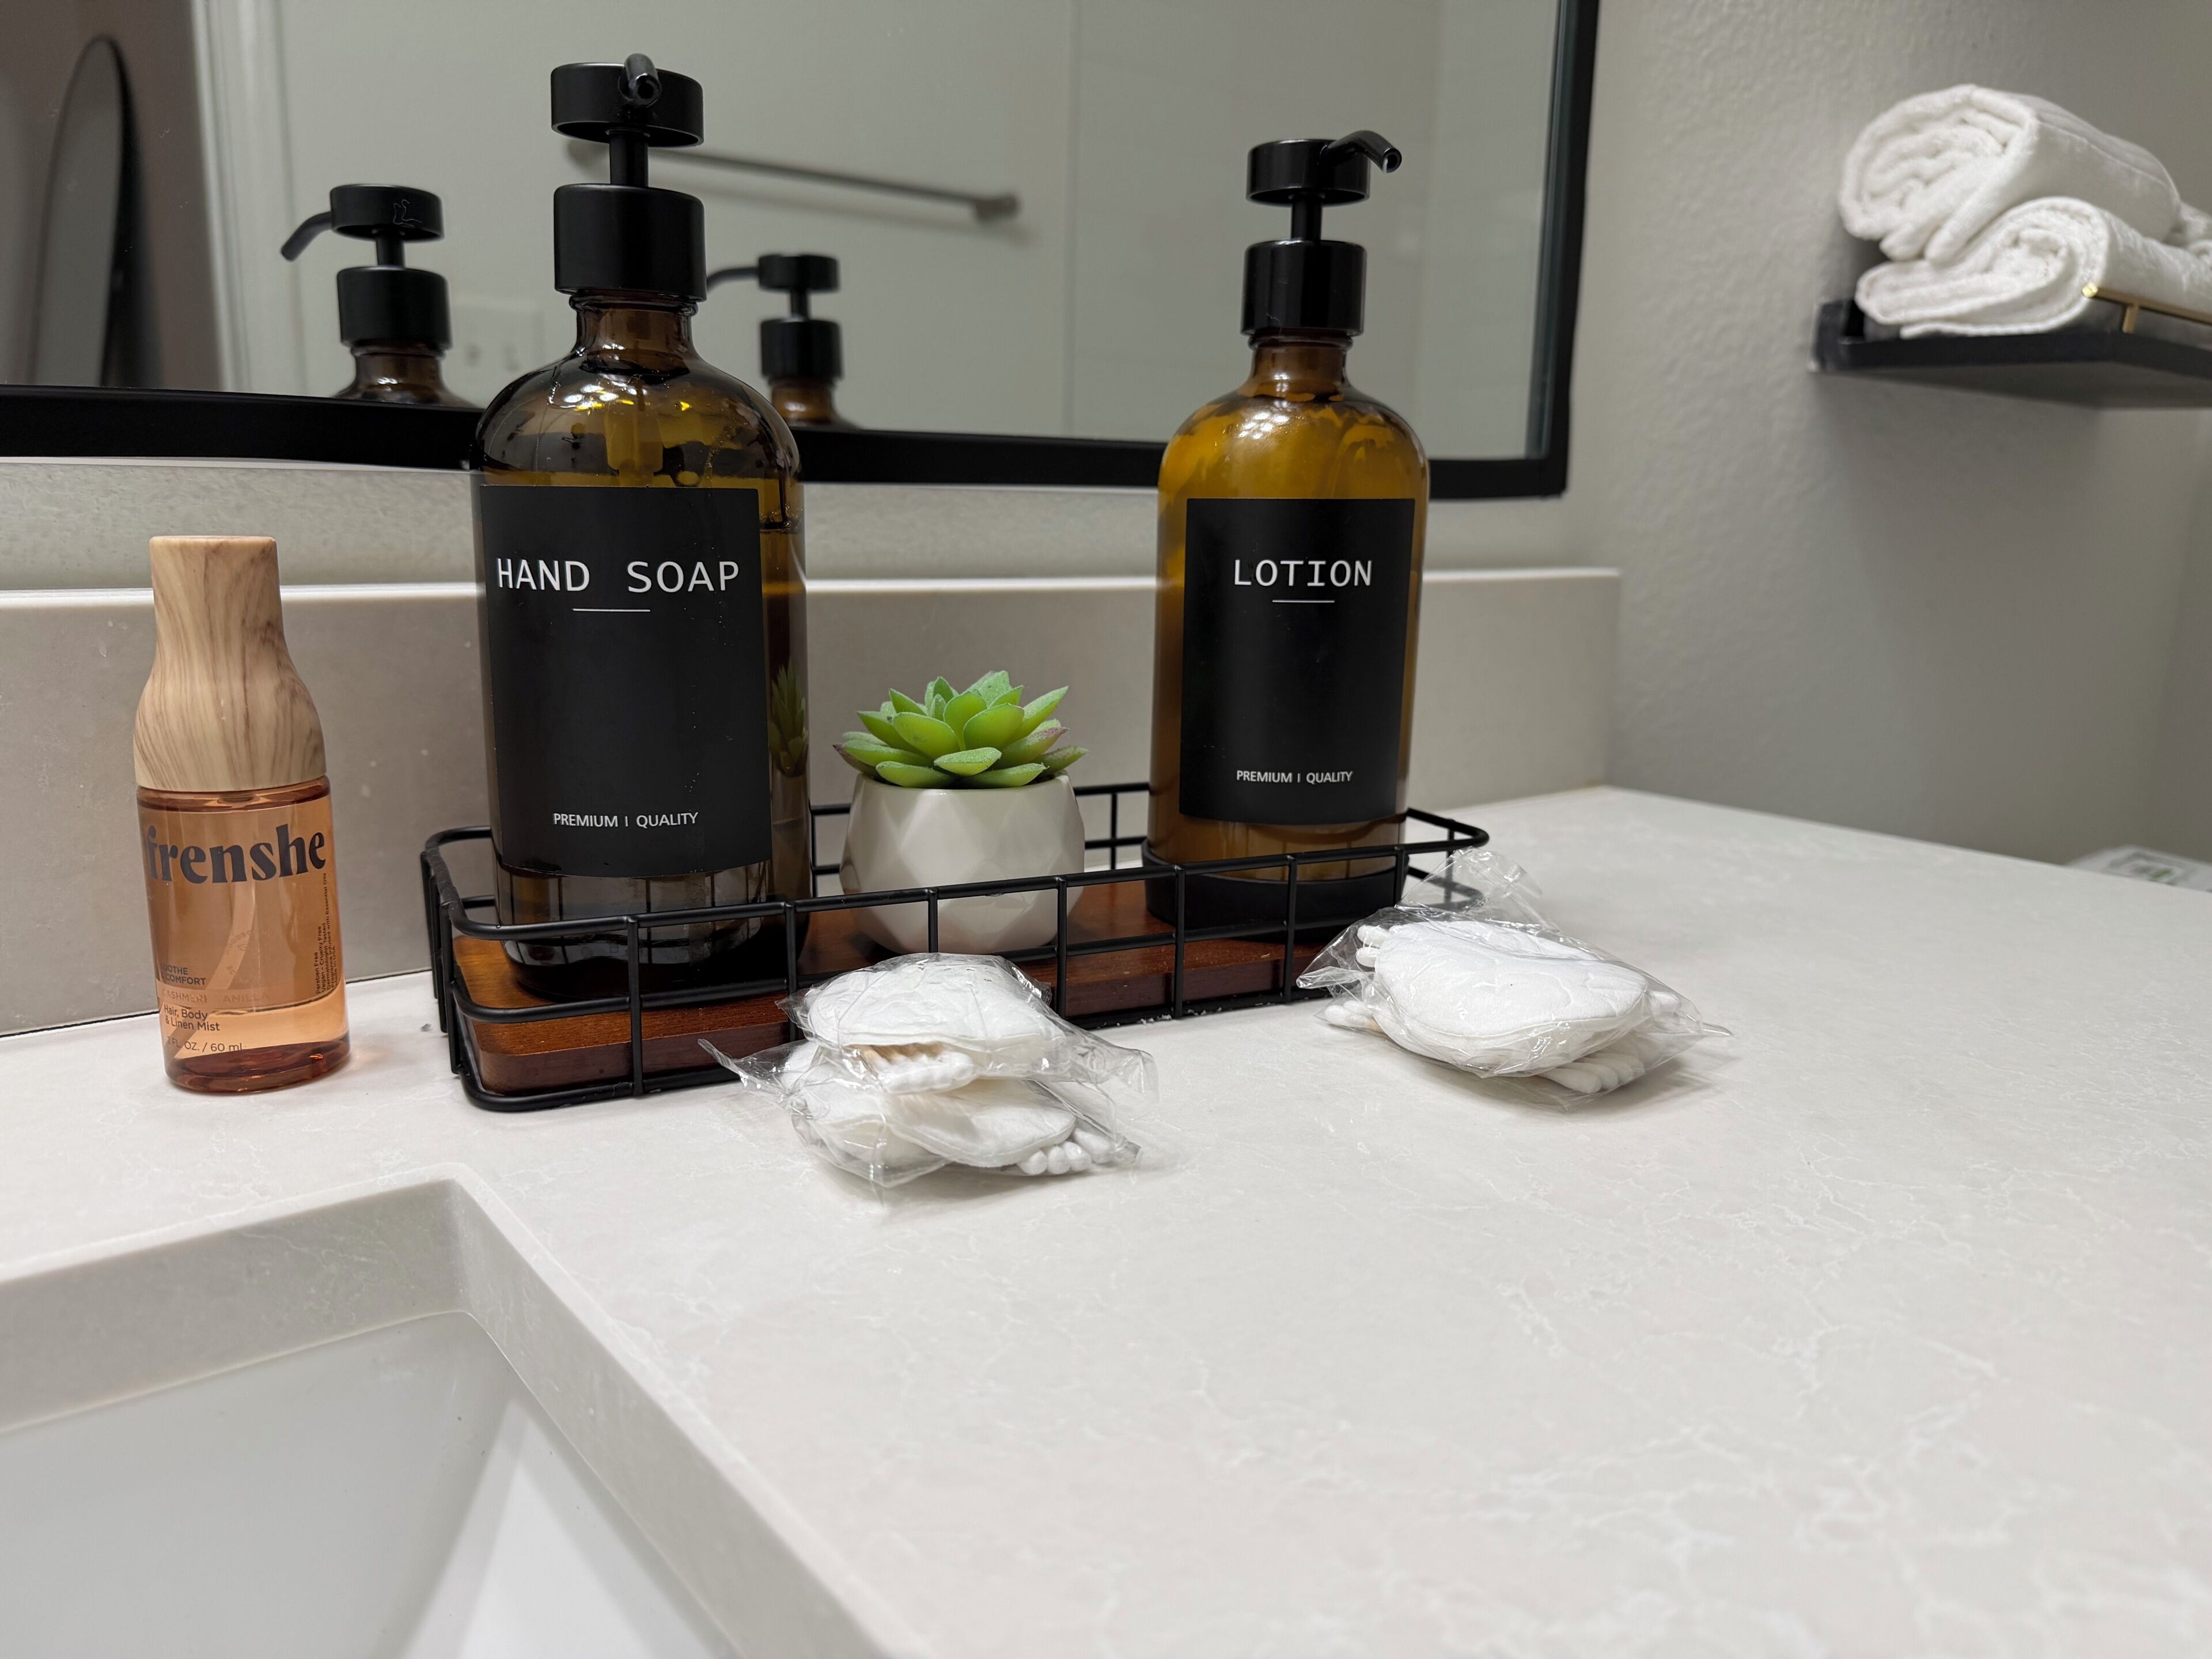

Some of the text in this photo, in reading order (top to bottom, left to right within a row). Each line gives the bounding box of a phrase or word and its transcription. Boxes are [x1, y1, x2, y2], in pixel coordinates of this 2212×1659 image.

[497, 557, 739, 593] HAND SOAP
[1234, 559, 1372, 588] LOTION
[1236, 770, 1293, 783] PREMIUM
[1306, 771, 1353, 785] QUALITY
[554, 813, 618, 828] PREMIUM
[636, 812, 699, 829] QUALITY
[146, 824, 327, 884] frenshe
[165, 974, 206, 986] COMFORT
[217, 991, 269, 1003] ANILLA
[164, 1004, 208, 1021] Hair, Body
[171, 1018, 194, 1030] Linen
[197, 1021, 220, 1031] Mist
[184, 1041, 199, 1051] OZ.
[211, 1043, 225, 1052] 60
